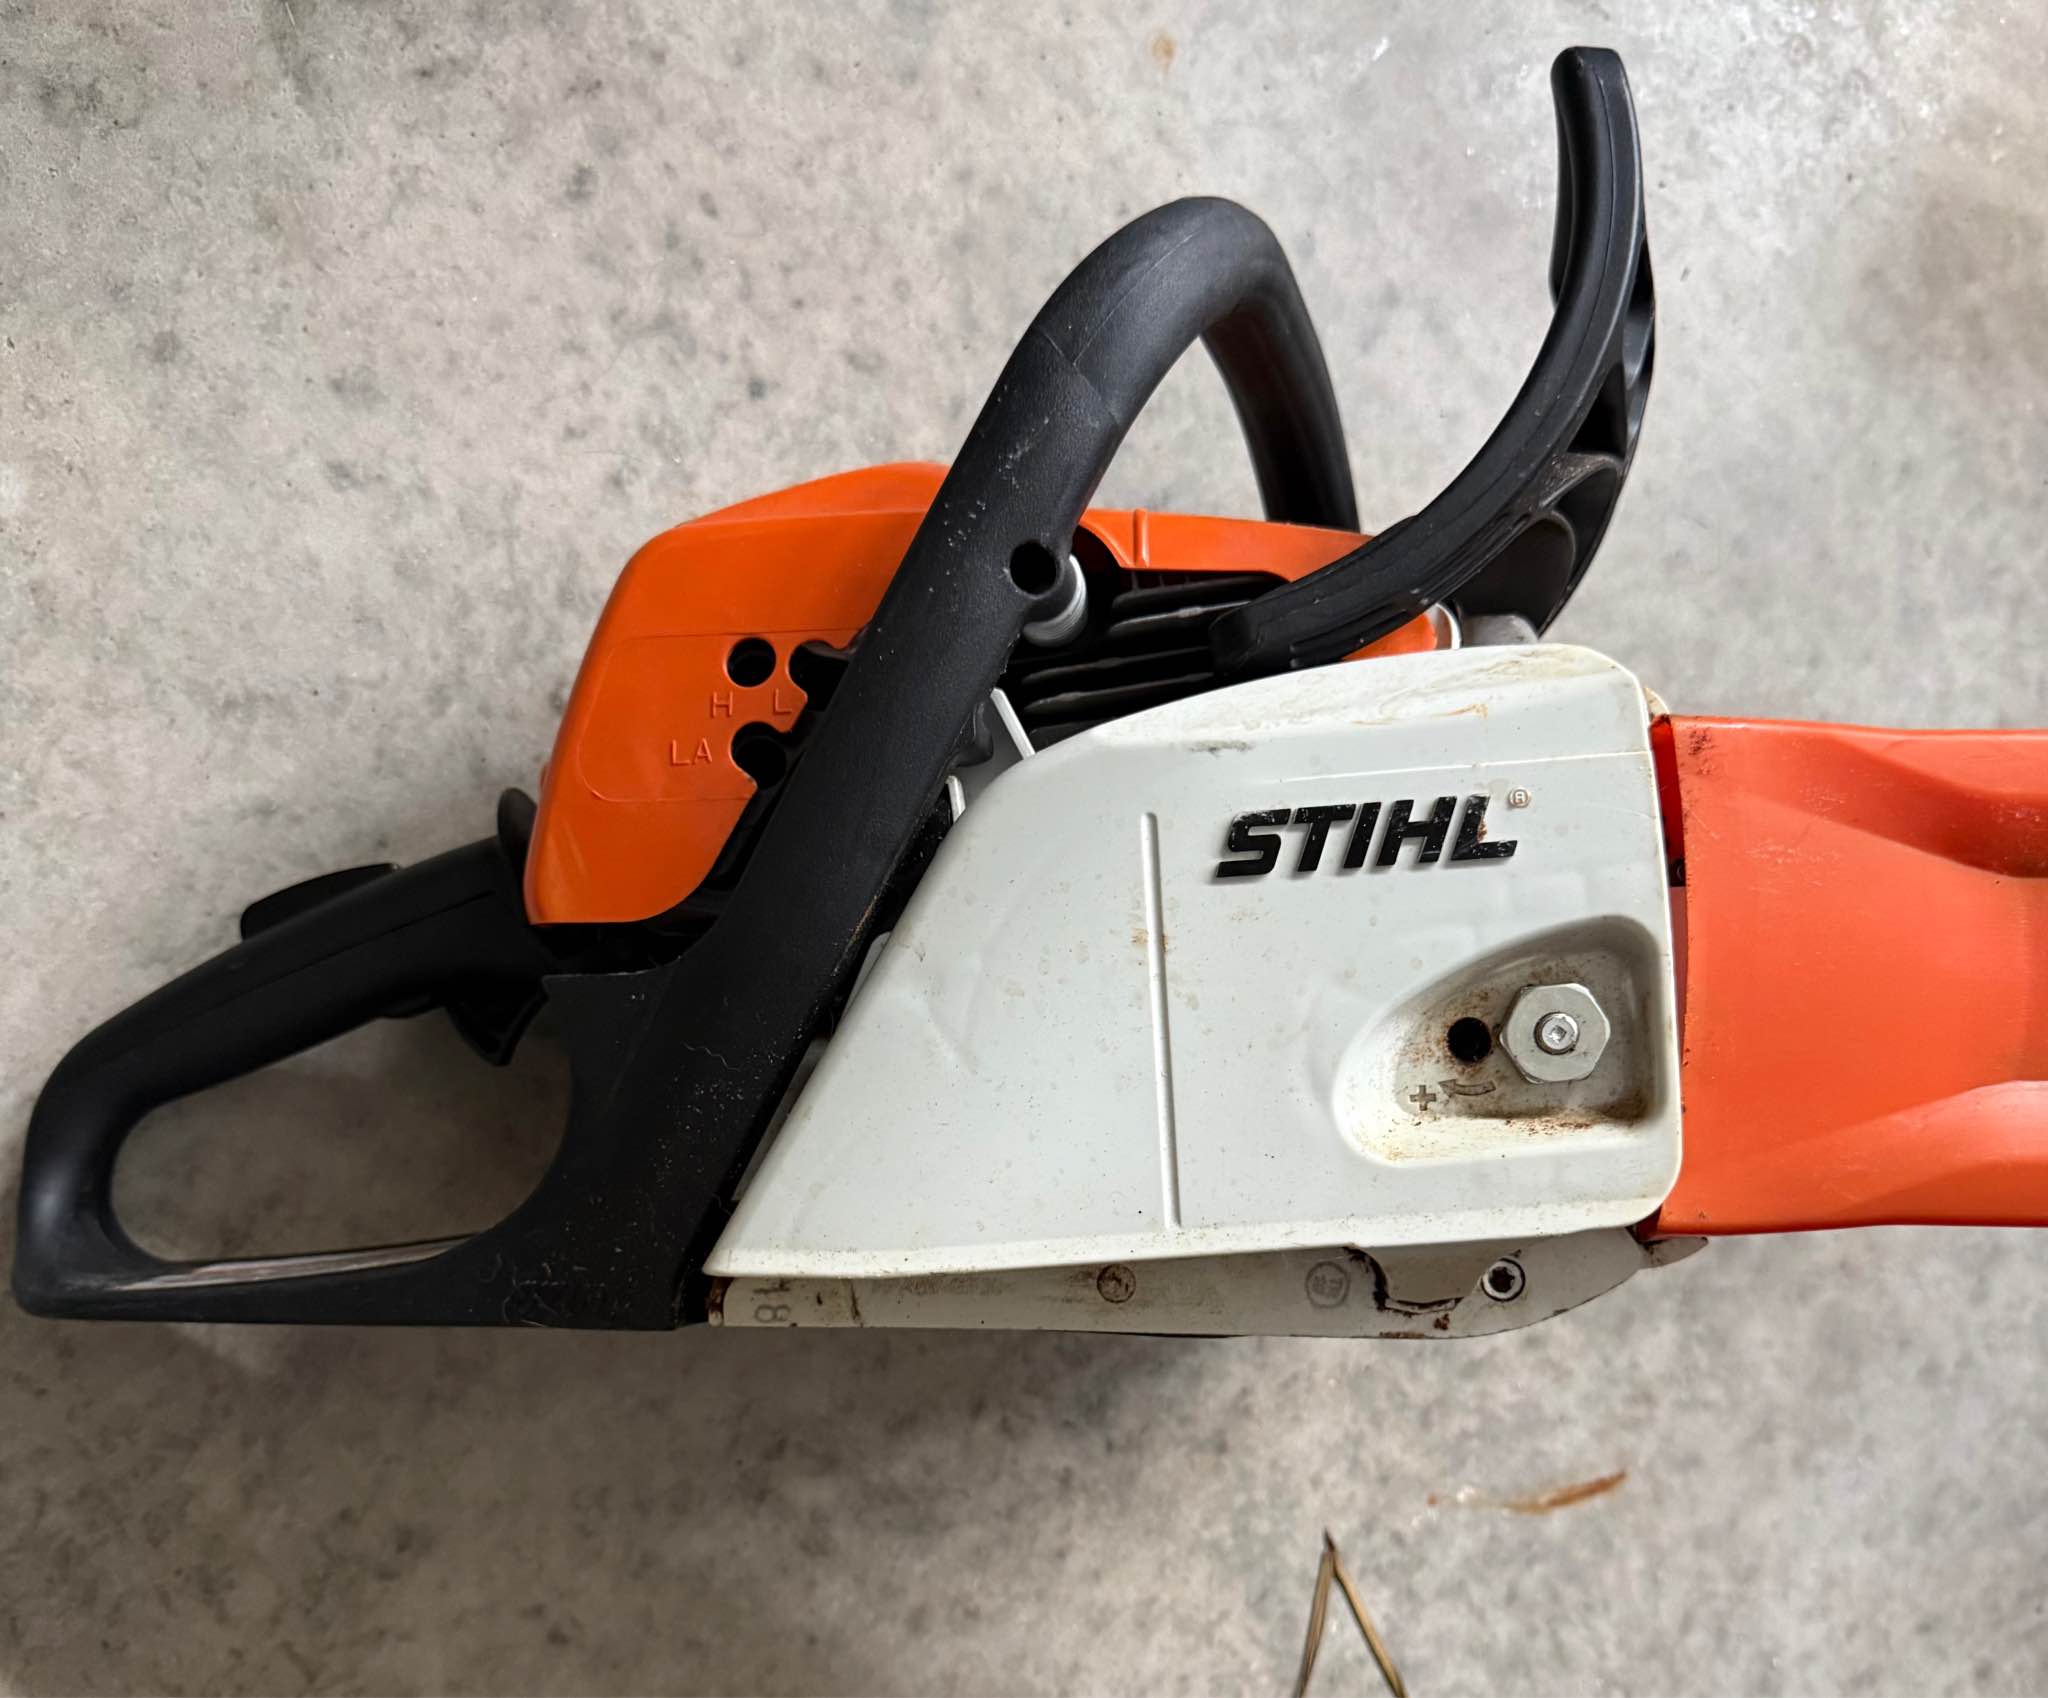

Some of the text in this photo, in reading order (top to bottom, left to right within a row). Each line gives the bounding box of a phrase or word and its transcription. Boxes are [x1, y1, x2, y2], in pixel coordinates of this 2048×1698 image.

[710, 688, 793, 719] H L
[670, 737, 713, 767] LA
[1215, 795, 1519, 878] STIHL
